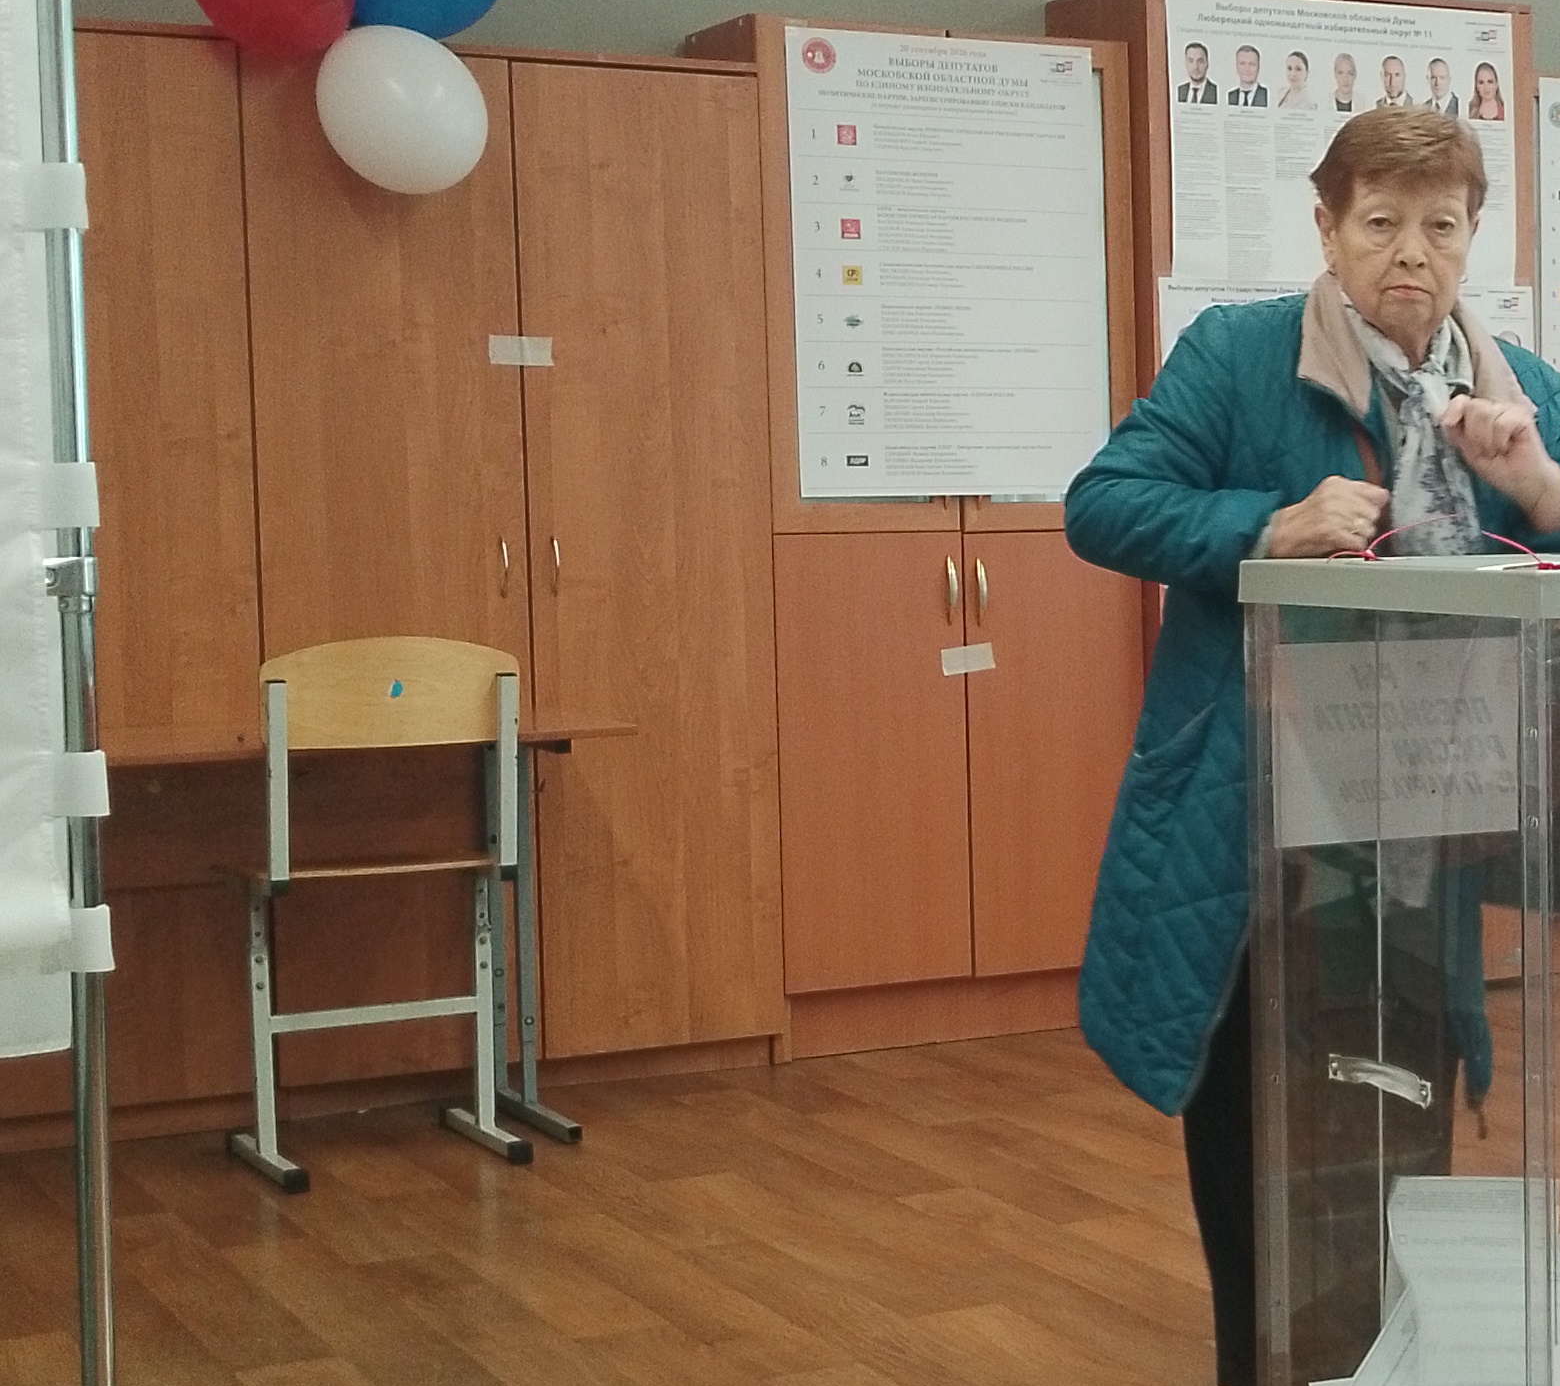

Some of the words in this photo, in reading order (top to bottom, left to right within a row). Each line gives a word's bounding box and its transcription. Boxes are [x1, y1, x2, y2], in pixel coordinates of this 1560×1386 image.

[1197, 13, 1252, 27] Люберецкий
[1254, 19, 1322, 31] одномандатный
[1324, 23, 1388, 35] избирательный
[1215, 2, 1252, 14] Выборы
[1253, 6, 1296, 17] депутатов
[1297, 9, 1347, 21] Московской
[1349, 12, 1391, 23] областной
[1392, 16, 1416, 26] Думы
[888, 57, 935, 69] ВЫБОРЫ
[937, 60, 998, 73] ДЕПУТАТОВ
[855, 80, 869, 88] ПО
[871, 81, 915, 91] ЕДИНОМУ
[917, 84, 996, 96] ИЗБИРАТЕЛЬНОМУ
[857, 68, 930, 82] МОСКОВСКОЙ
[932, 73, 996, 86] ОБЛАСТНОЙ
[998, 78, 1028, 88] ДУМЫ
